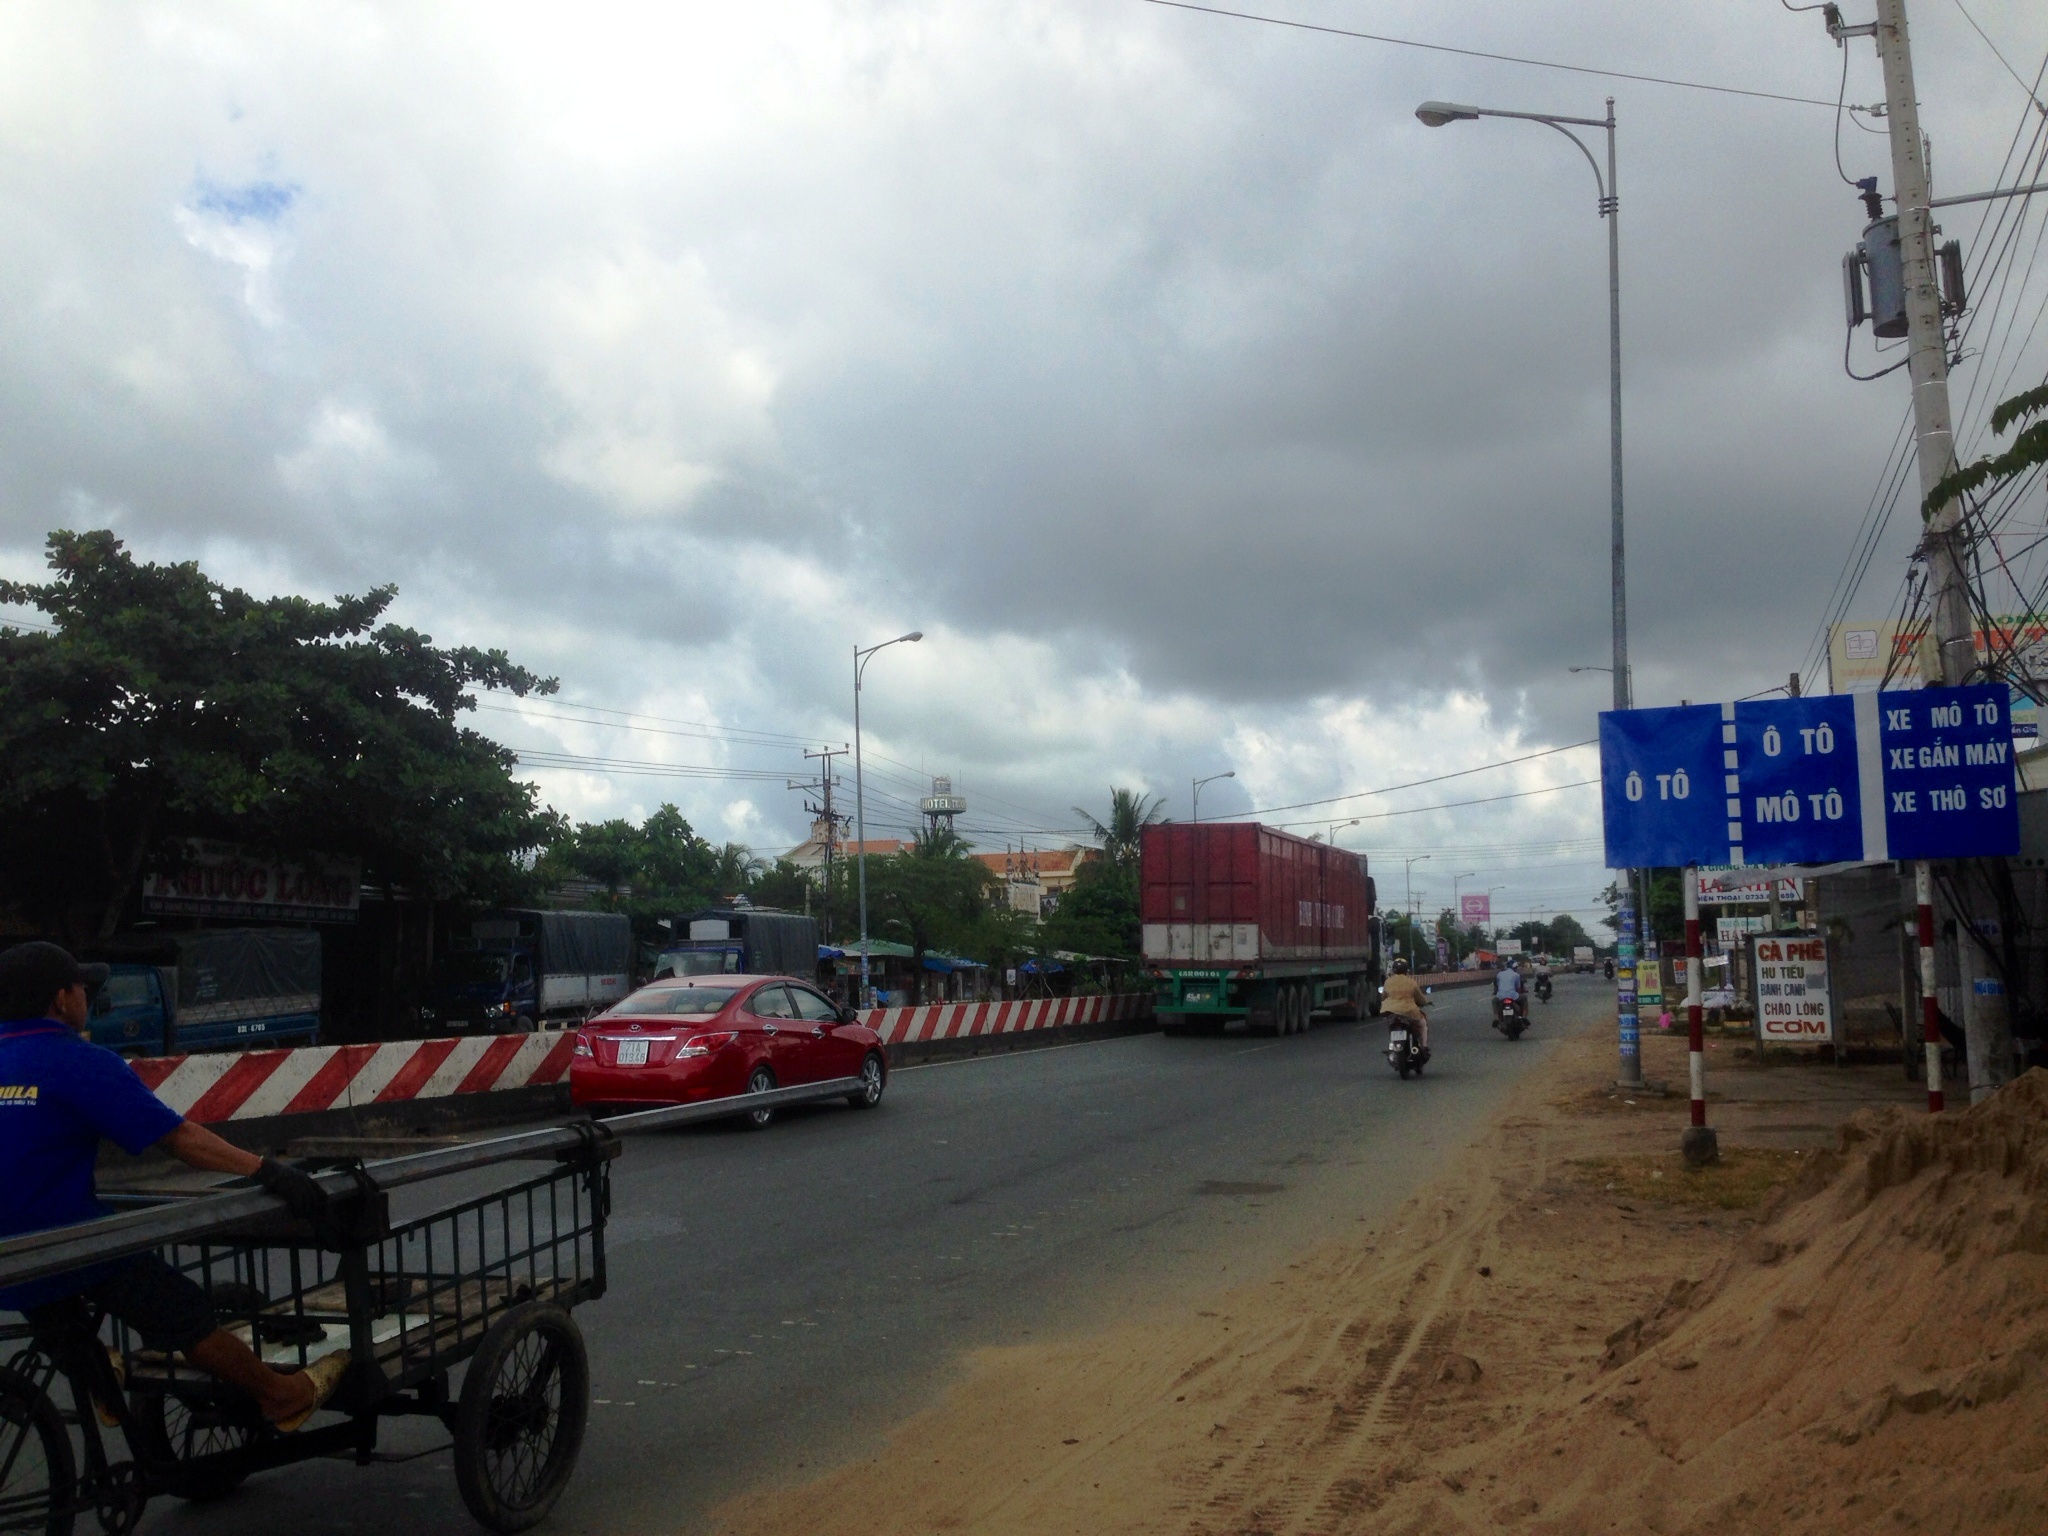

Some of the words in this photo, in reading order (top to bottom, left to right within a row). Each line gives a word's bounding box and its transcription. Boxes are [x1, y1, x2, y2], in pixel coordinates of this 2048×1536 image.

[1886, 709, 1912, 731] XE
[1931, 700, 1962, 729] MÔ
[1973, 698, 1999, 725] TÔ
[1762, 724, 1782, 757] Ô
[1799, 721, 1835, 755] TÔ
[1889, 748, 1915, 770] XE
[1918, 736, 1960, 768] GẮN
[1965, 737, 2008, 766] MÁY
[1625, 770, 1643, 802] Ô
[1656, 768, 1690, 800] TÔ
[1892, 791, 1917, 813] XE
[1929, 784, 1967, 811] THÔ
[1979, 784, 2007, 809] SƠ
[922, 799, 949, 808] HOTEL
[1756, 789, 1801, 823] MÔ
[1808, 787, 1843, 821] TÔ
[1758, 940, 1783, 962] CÀ
[1786, 939, 1826, 962] PHÊ
[1766, 1019, 1826, 1034] CƠM
